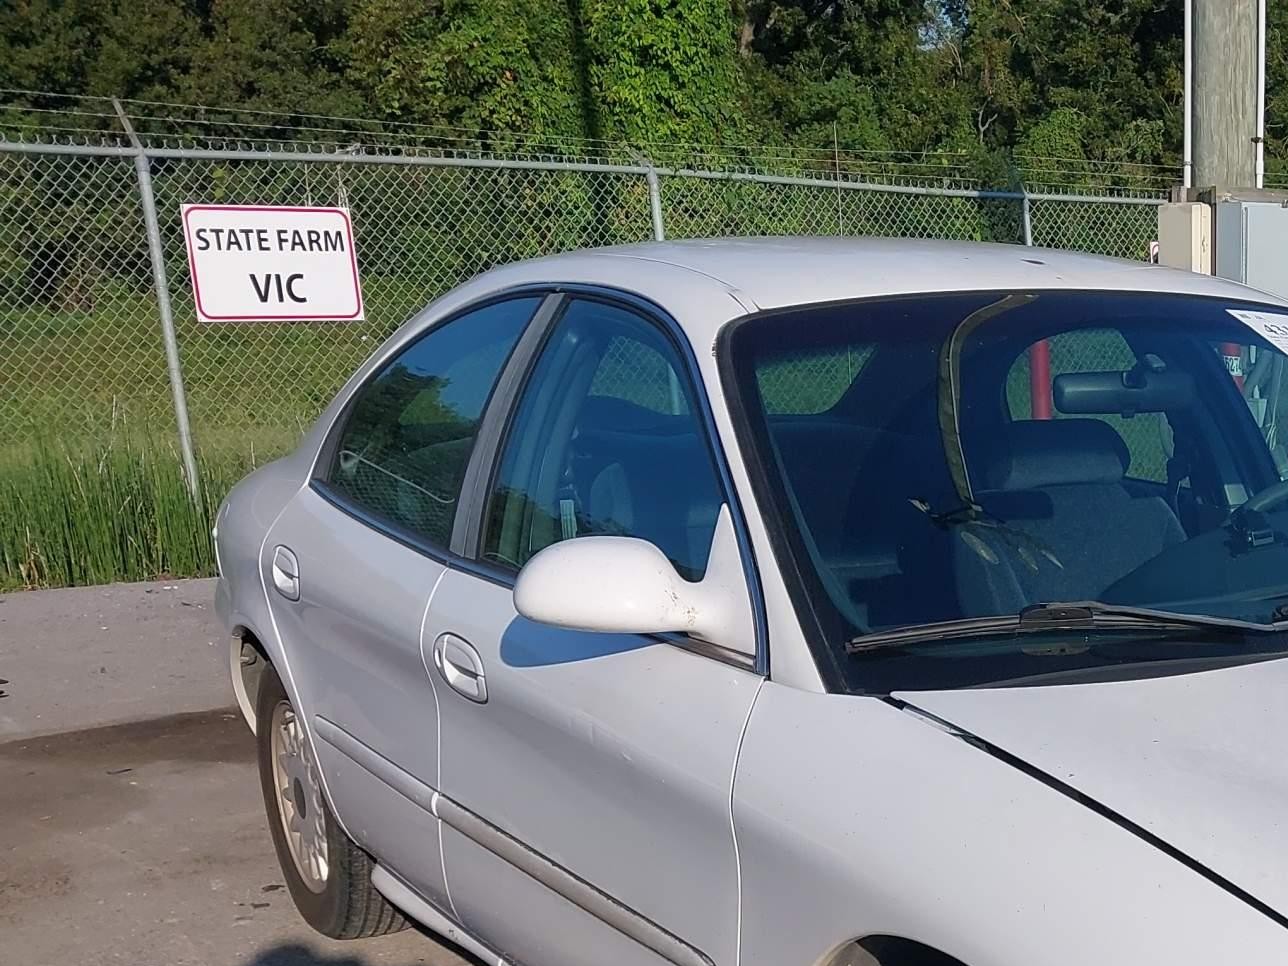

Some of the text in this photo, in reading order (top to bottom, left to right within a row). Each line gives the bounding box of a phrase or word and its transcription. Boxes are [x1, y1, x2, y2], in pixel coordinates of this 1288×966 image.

[195, 228, 345, 253] STATE FARM
[248, 273, 308, 304] VIC
